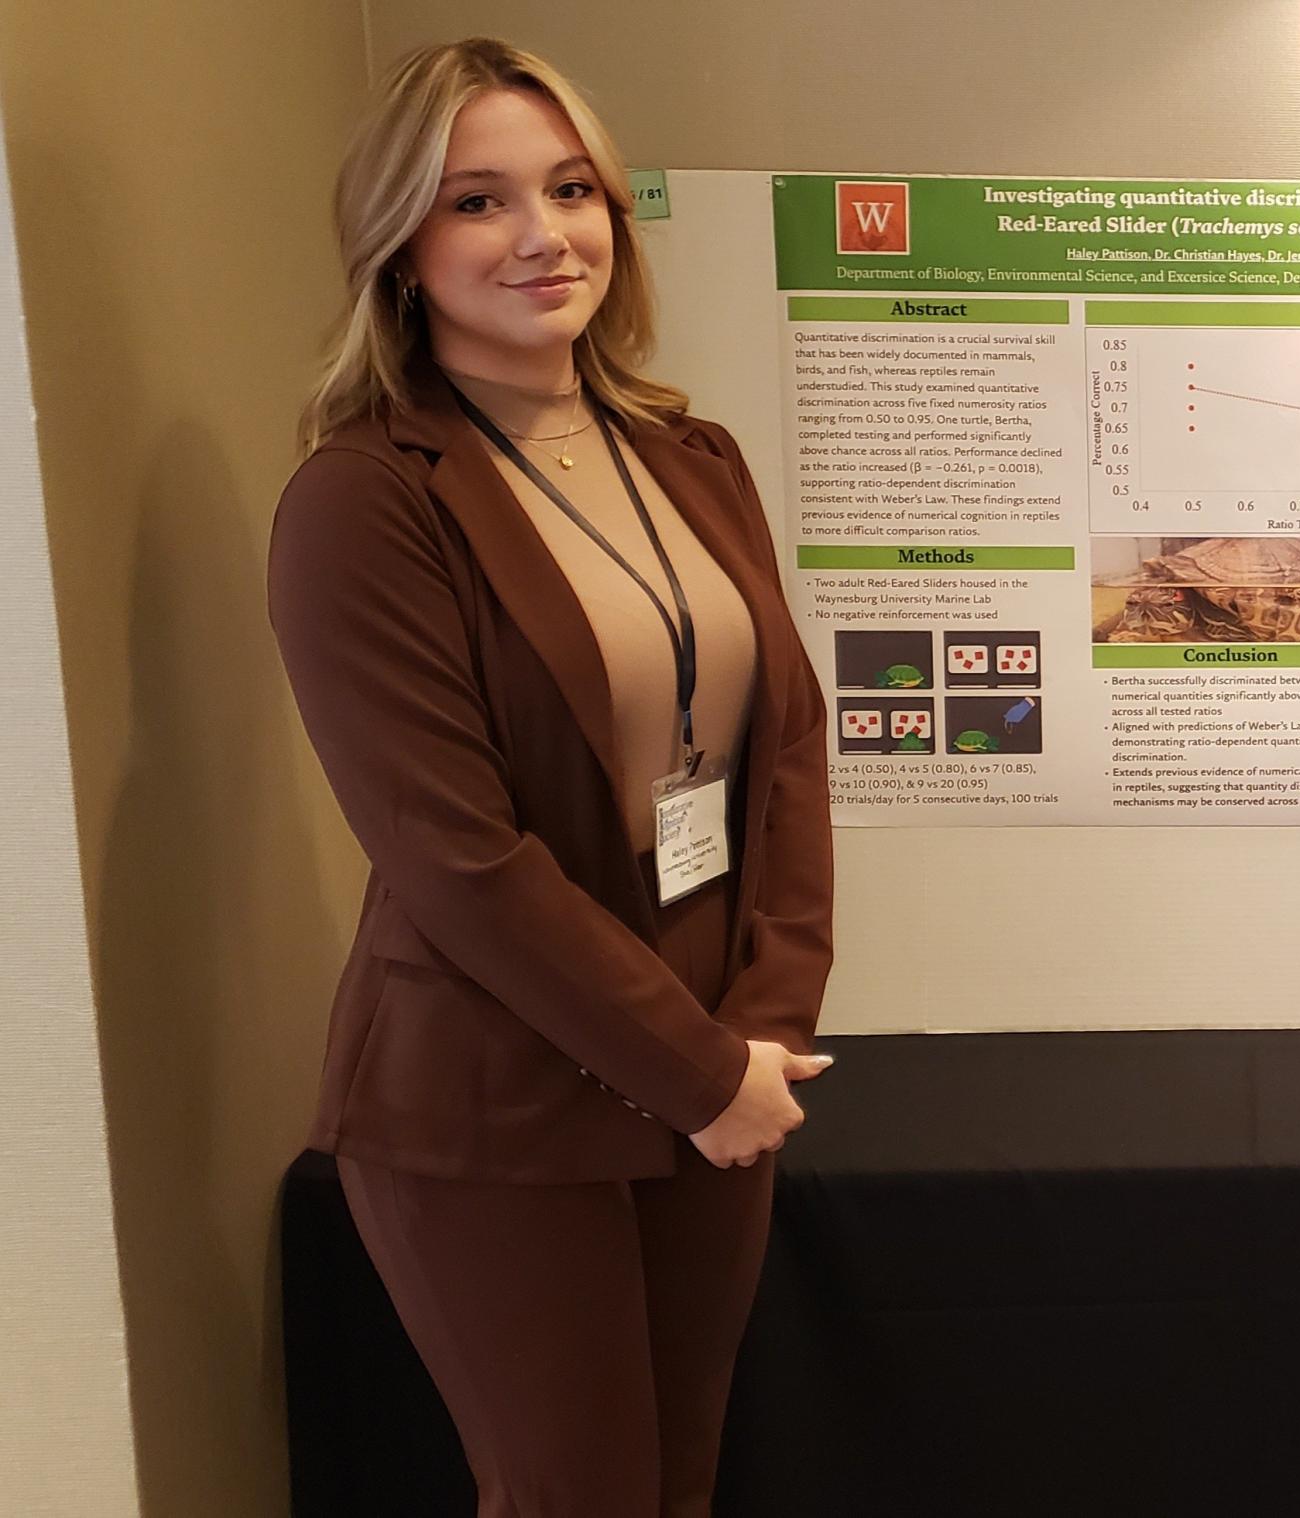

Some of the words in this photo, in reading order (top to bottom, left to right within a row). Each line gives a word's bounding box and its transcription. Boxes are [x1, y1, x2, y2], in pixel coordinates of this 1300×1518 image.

[647, 188, 662, 199] 81
[983, 186, 1116, 208] Investigating
[1119, 188, 1242, 209] quantitative
[851, 201, 894, 233] W
[997, 215, 1103, 232] Red-Eared
[1106, 215, 1167, 233] Slider
[1171, 216, 1284, 239] (Trachemys
[1066, 247, 1101, 261] Haley
[1100, 248, 1151, 261] Pattison,
[1152, 249, 1173, 261] Dr.
[1172, 248, 1226, 261] Christian
[1225, 249, 1266, 263] Hayes,
[1265, 250, 1285, 262] Dr.
[836, 266, 915, 282] Department
[916, 266, 932, 279] of
[933, 267, 985, 283] Biology,
[987, 268, 1083, 281] Environmental
[1085, 269, 1138, 284] Science,
[1140, 269, 1165, 282] and
[1167, 270, 1226, 283] Excersice
[1228, 270, 1280, 285] Science,
[890, 300, 967, 316] Abstract
[794, 331, 859, 344] Quantitative
[860, 332, 935, 343] discrimination
[937, 333, 946, 343] is
[956, 333, 990, 344] crucial
[993, 334, 1032, 344] survival
[1035, 334, 1055, 344] skill
[1102, 339, 1127, 350] 0.85
[1110, 360, 1127, 371] 0.8
[1091, 370, 1101, 408] Correct
[1103, 381, 1127, 392] 0.75
[1110, 402, 1128, 412] 0.7
[1104, 422, 1128, 433] 0.65
[1092, 411, 1103, 466] Percentage
[1111, 444, 1128, 454] 0.6
[1105, 464, 1129, 475] 0.55
[1112, 485, 1129, 495] 0.5
[1132, 500, 1149, 511] 0.4
[1184, 500, 1202, 511] 0.5
[1237, 500, 1255, 511] 0.6
[1267, 519, 1294, 528] Ratio
[897, 548, 974, 563] Methods
[813, 577, 836, 587] Two
[838, 577, 865, 587] adult
[867, 578, 920, 588] Red-Eared
[922, 578, 958, 588] Sliders
[959, 578, 996, 588] housed
[999, 578, 1009, 588] in
[1011, 578, 1028, 588] the
[814, 593, 878, 606] Waynesburg
[880, 593, 932, 606] University
[935, 594, 970, 604] Marine
[973, 594, 992, 604] Lab
[815, 609, 831, 619] No
[833, 609, 876, 621] negative
[878, 609, 950, 619] reinforcement
[974, 609, 998, 619] used
[1183, 647, 1278, 662] Conclusion
[1111, 675, 1145, 685] Bertha
[1147, 675, 1207, 687] successfully
[1209, 675, 1277, 685] discriminated
[1111, 722, 1150, 734] Aligned
[1152, 721, 1175, 731] with
[1177, 721, 1233, 733] predictions
[1235, 720, 1247, 730] of
